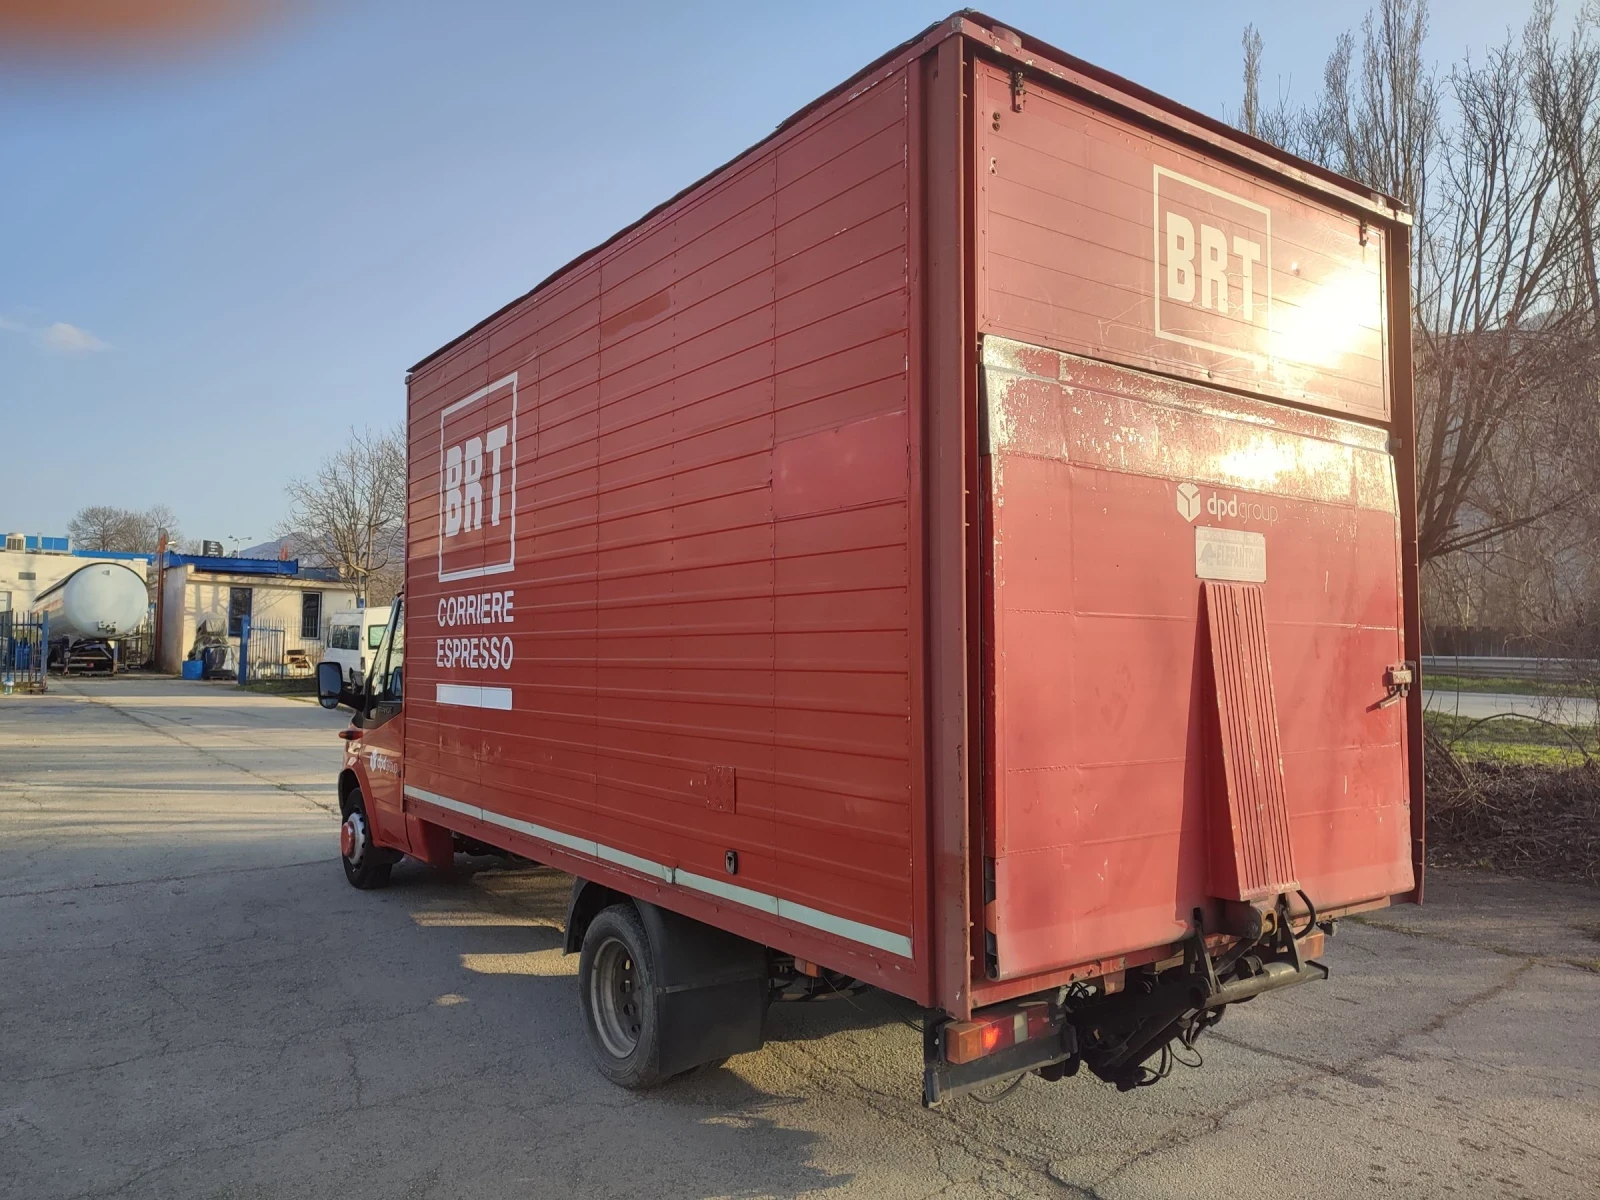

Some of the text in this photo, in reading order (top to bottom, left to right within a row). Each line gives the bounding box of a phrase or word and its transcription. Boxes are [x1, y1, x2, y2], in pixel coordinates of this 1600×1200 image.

[1166, 211, 1261, 321] BRT
[445, 424, 508, 537] BRT
[437, 590, 514, 627] CORRIERE
[436, 636, 514, 670] ESPRESSO
